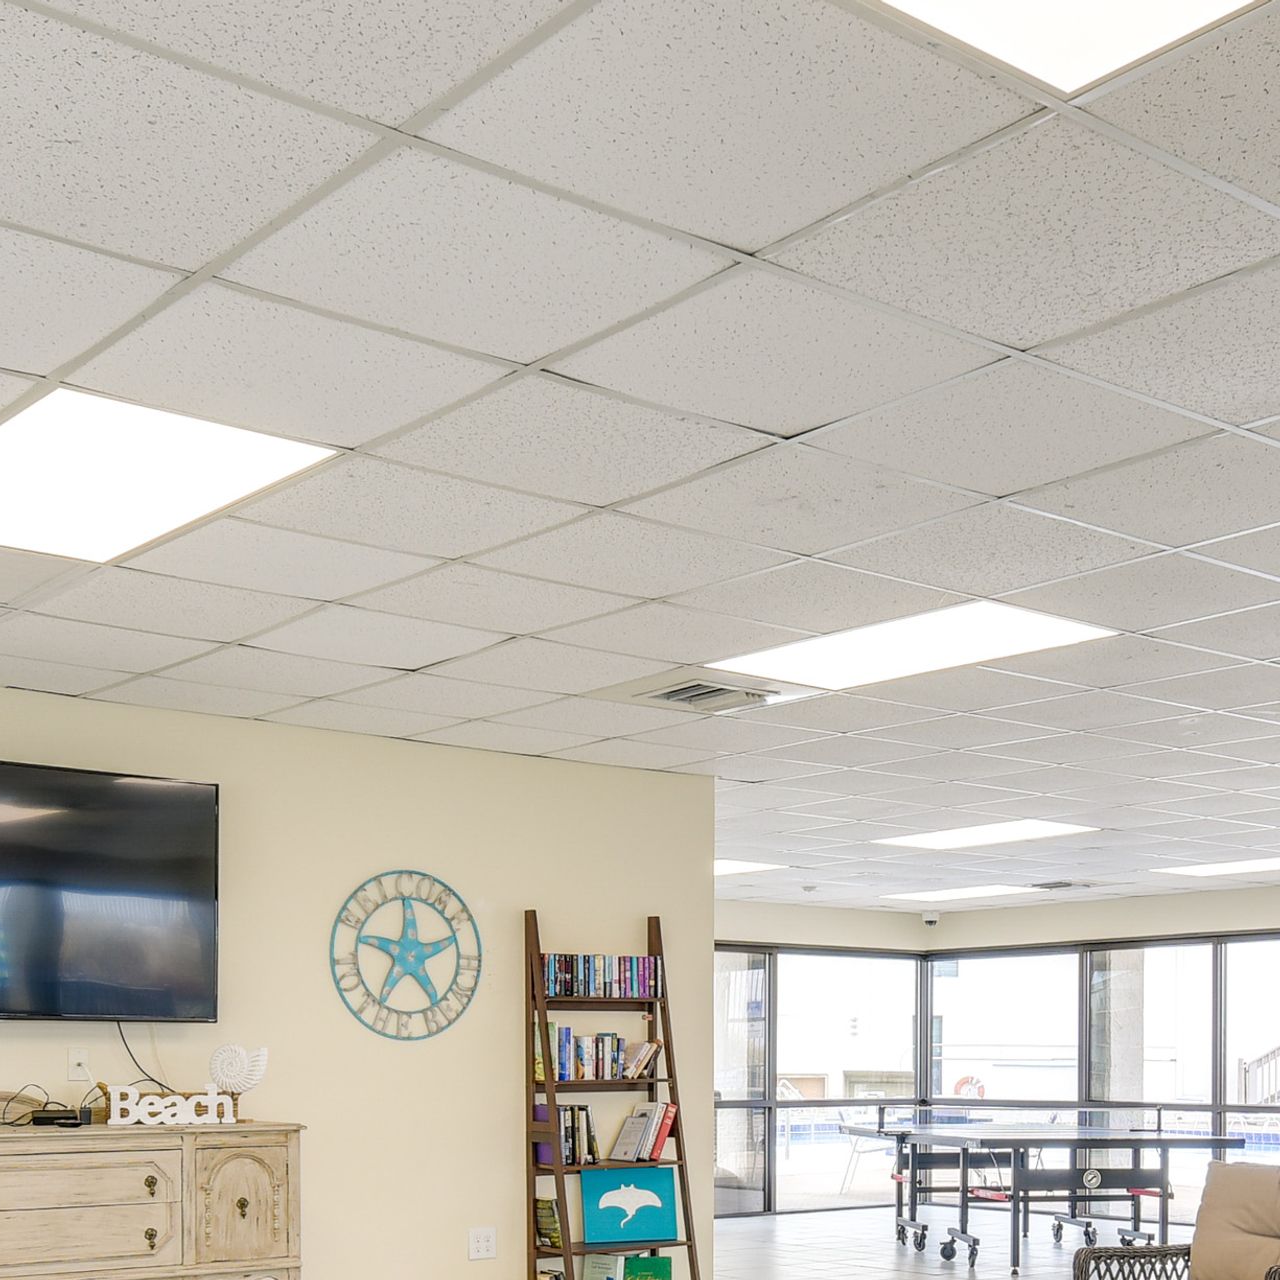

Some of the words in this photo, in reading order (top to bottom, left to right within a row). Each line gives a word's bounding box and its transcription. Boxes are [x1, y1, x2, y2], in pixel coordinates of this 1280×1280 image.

[338, 872, 471, 932] WELCOME
[334, 952, 361, 992] TO
[357, 993, 412, 1038] THE
[423, 955, 481, 1035] BEACH
[107, 1084, 236, 1125] Beach
